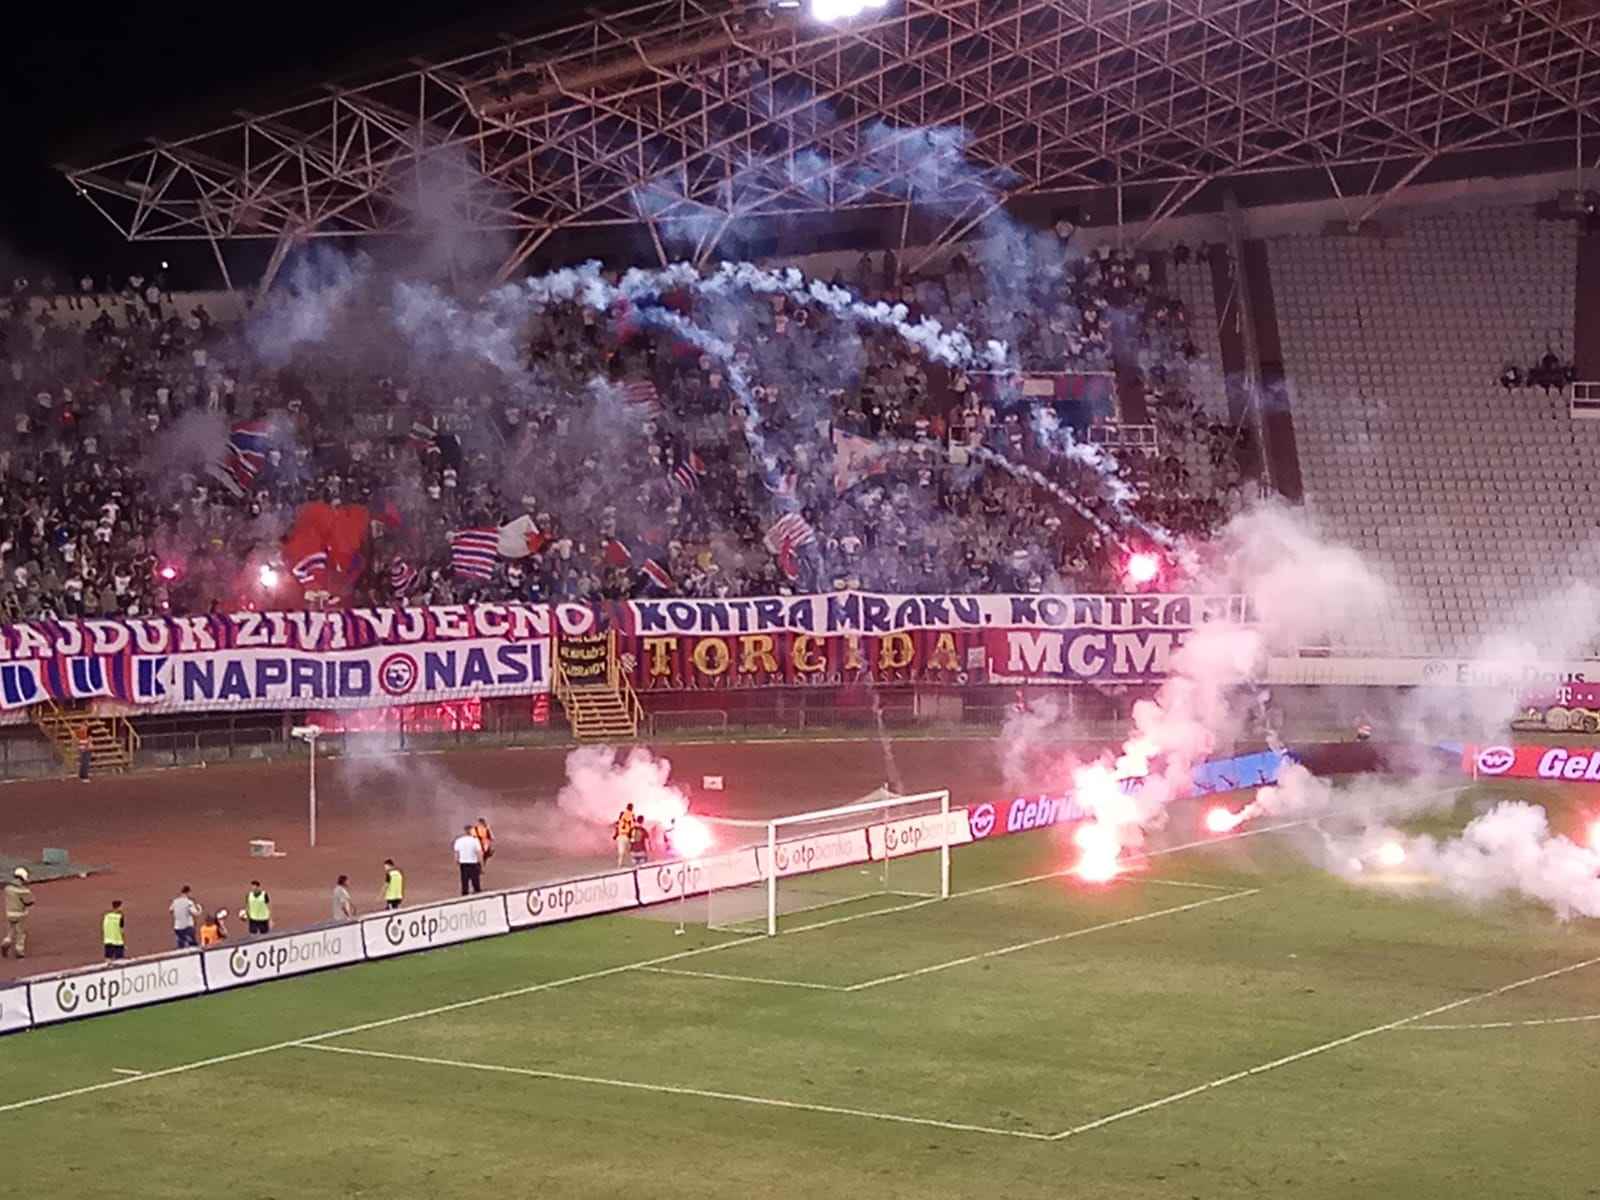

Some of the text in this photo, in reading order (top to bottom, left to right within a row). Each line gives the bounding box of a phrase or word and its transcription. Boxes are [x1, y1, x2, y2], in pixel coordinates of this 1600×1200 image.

[634, 598, 814, 632] KONTRA
[1010, 597, 1192, 626] KONTRA
[643, 632, 964, 676] TORCIDA
[183, 658, 372, 700] NAPRID
